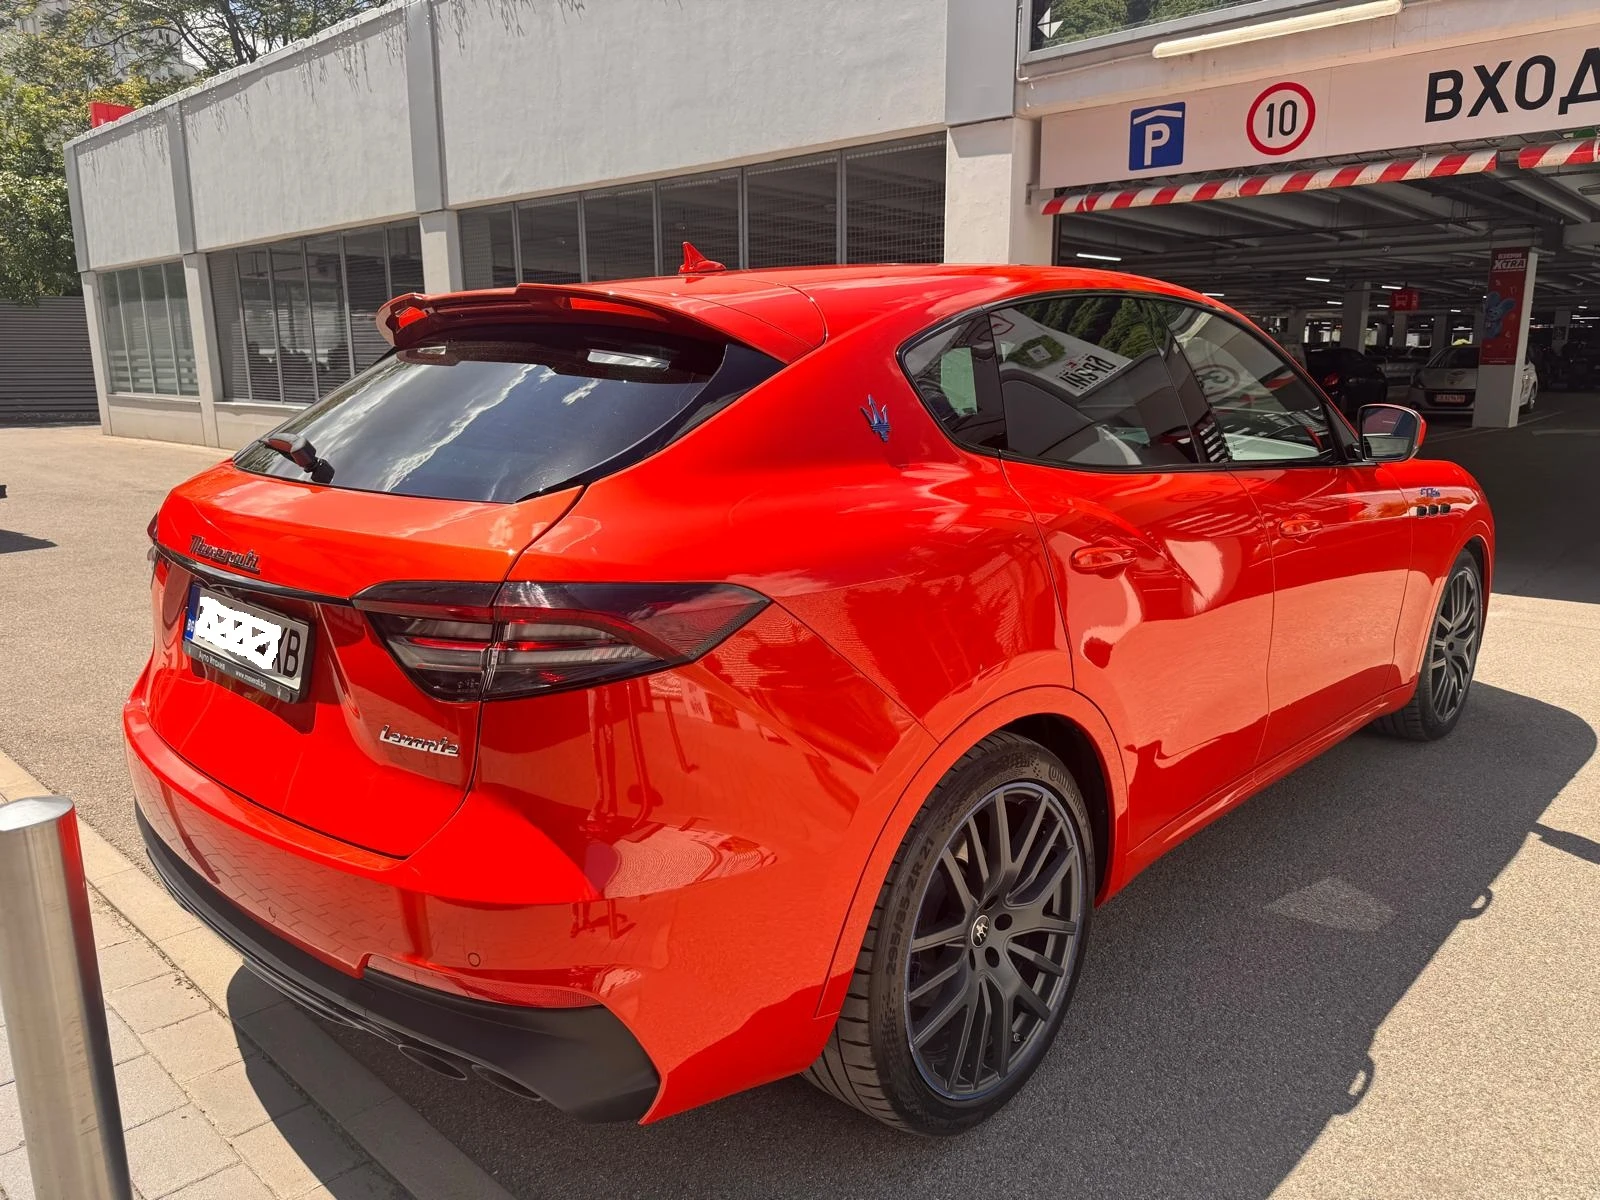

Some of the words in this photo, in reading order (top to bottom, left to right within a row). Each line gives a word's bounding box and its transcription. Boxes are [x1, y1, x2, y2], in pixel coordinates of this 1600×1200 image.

[1425, 46, 1600, 123] ВХОД
[1266, 99, 1298, 138] 10
[1144, 122, 1171, 167] P
[190, 534, 260, 569] Maserati
[379, 724, 459, 758] Levante
